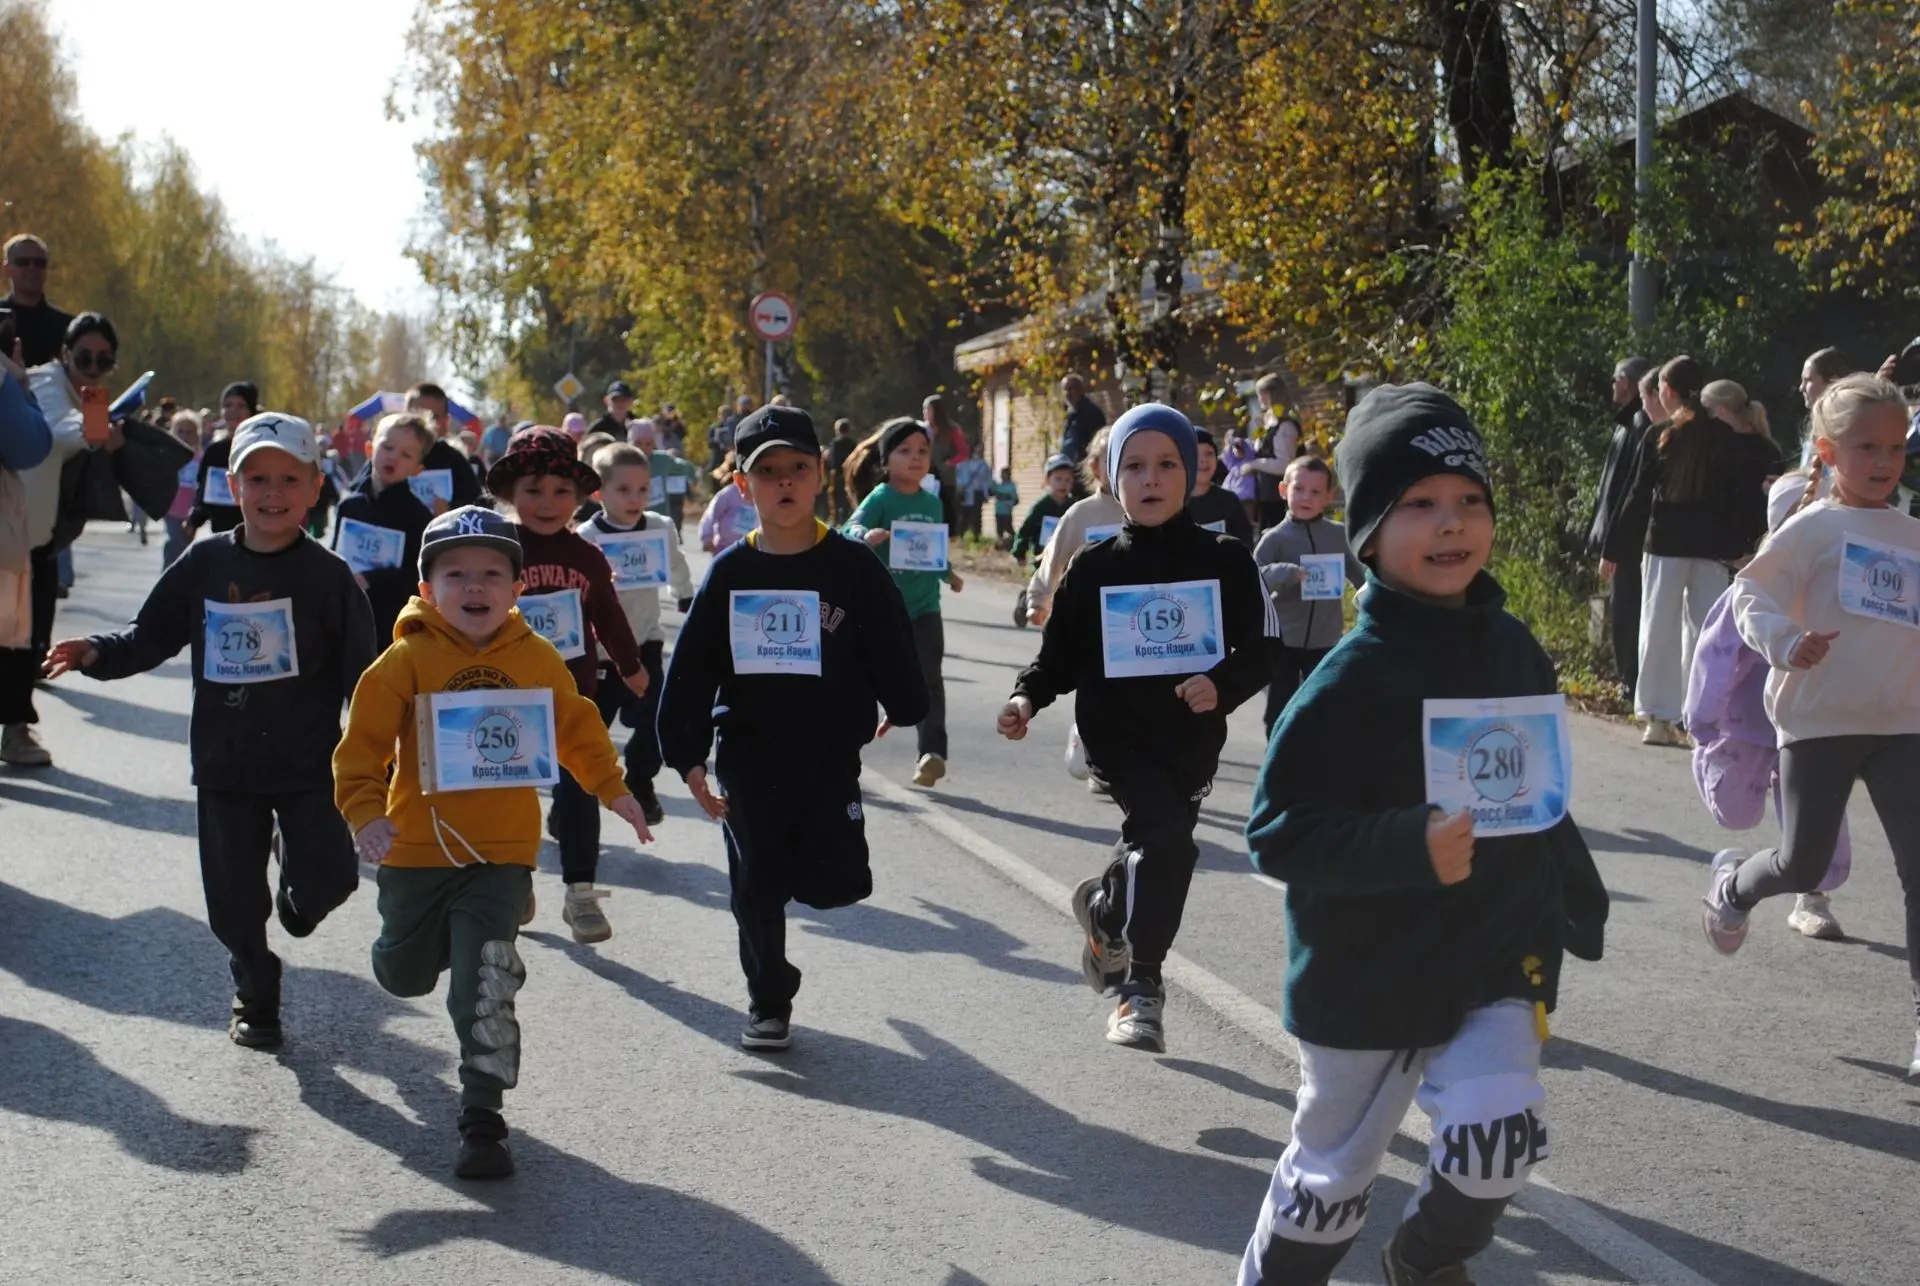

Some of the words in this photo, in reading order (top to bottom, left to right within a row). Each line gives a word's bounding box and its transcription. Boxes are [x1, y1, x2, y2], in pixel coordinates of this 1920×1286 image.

[457, 513, 483, 534] NY
[622, 551, 646, 567] 260
[519, 564, 590, 601] OGWART
[1872, 567, 1902, 592] 190
[765, 612, 801, 632] 211
[820, 601, 845, 632] RD
[1143, 608, 1184, 631] 159
[221, 631, 259, 651] 278
[757, 643, 785, 657] Кросс
[786, 643, 812, 657] Нации
[1135, 644, 1165, 658] Кросс
[1166, 642, 1195, 656] Нации
[483, 669, 498, 680] NO
[479, 726, 516, 749] 256
[472, 764, 501, 778] Кросс
[502, 763, 529, 777] Нации
[1473, 746, 1523, 780] 280
[1468, 806, 1502, 824] росс
[1441, 1108, 1549, 1180] HYPE
